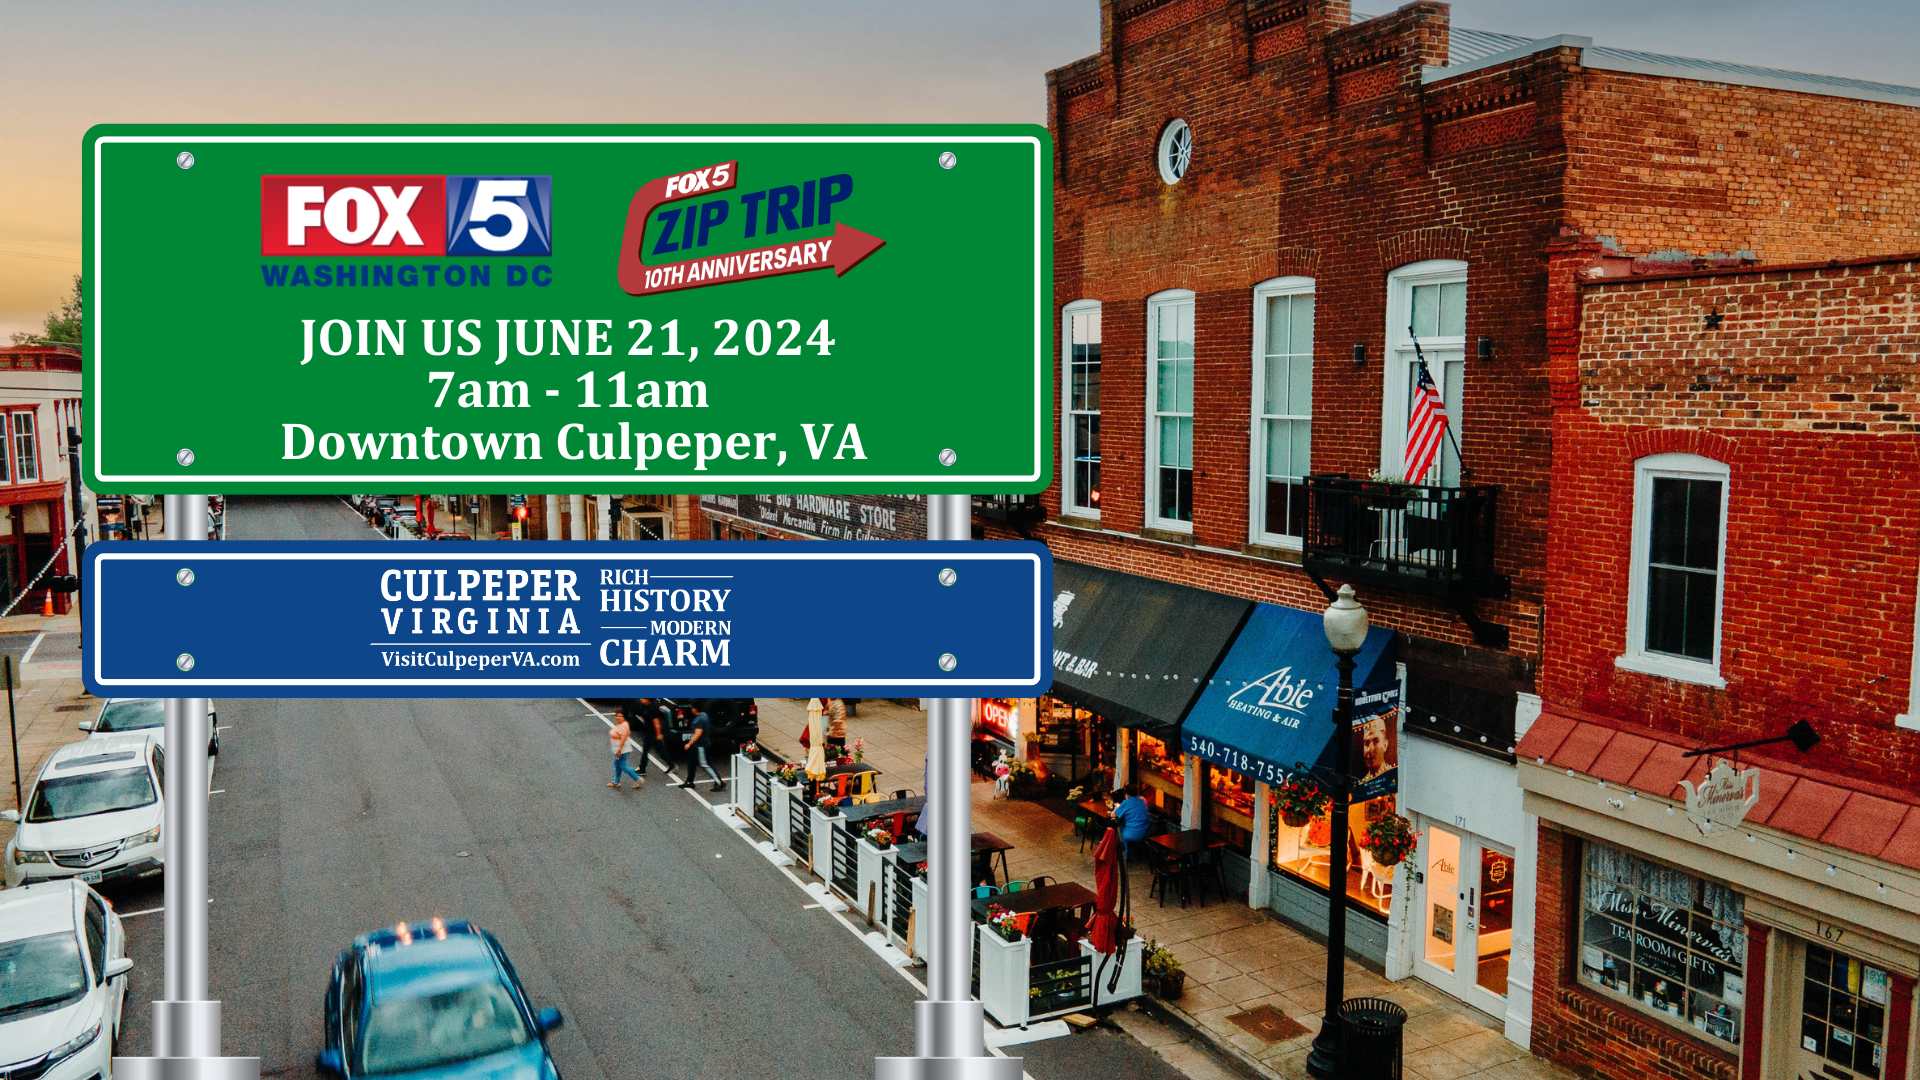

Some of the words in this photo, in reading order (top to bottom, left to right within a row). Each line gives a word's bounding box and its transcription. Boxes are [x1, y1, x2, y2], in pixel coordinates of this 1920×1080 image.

[776, 494, 791, 508] BIG
[796, 494, 851, 521] HARDWARE
[860, 504, 897, 532] STORE
[821, 520, 840, 537] Firm
[1065, 656, 1079, 673] &
[1073, 658, 1099, 679] BAR
[1227, 666, 1314, 712] Able
[984, 702, 1011, 728] OPEN
[1228, 699, 1273, 720] HEATING
[1271, 713, 1282, 723] &
[1281, 717, 1301, 729] AIR
[1454, 815, 1467, 829] 171
[1431, 858, 1457, 876] Able
[1598, 892, 1640, 915] Miss
[1610, 922, 1632, 942] TEA
[1816, 921, 1845, 942] 167
